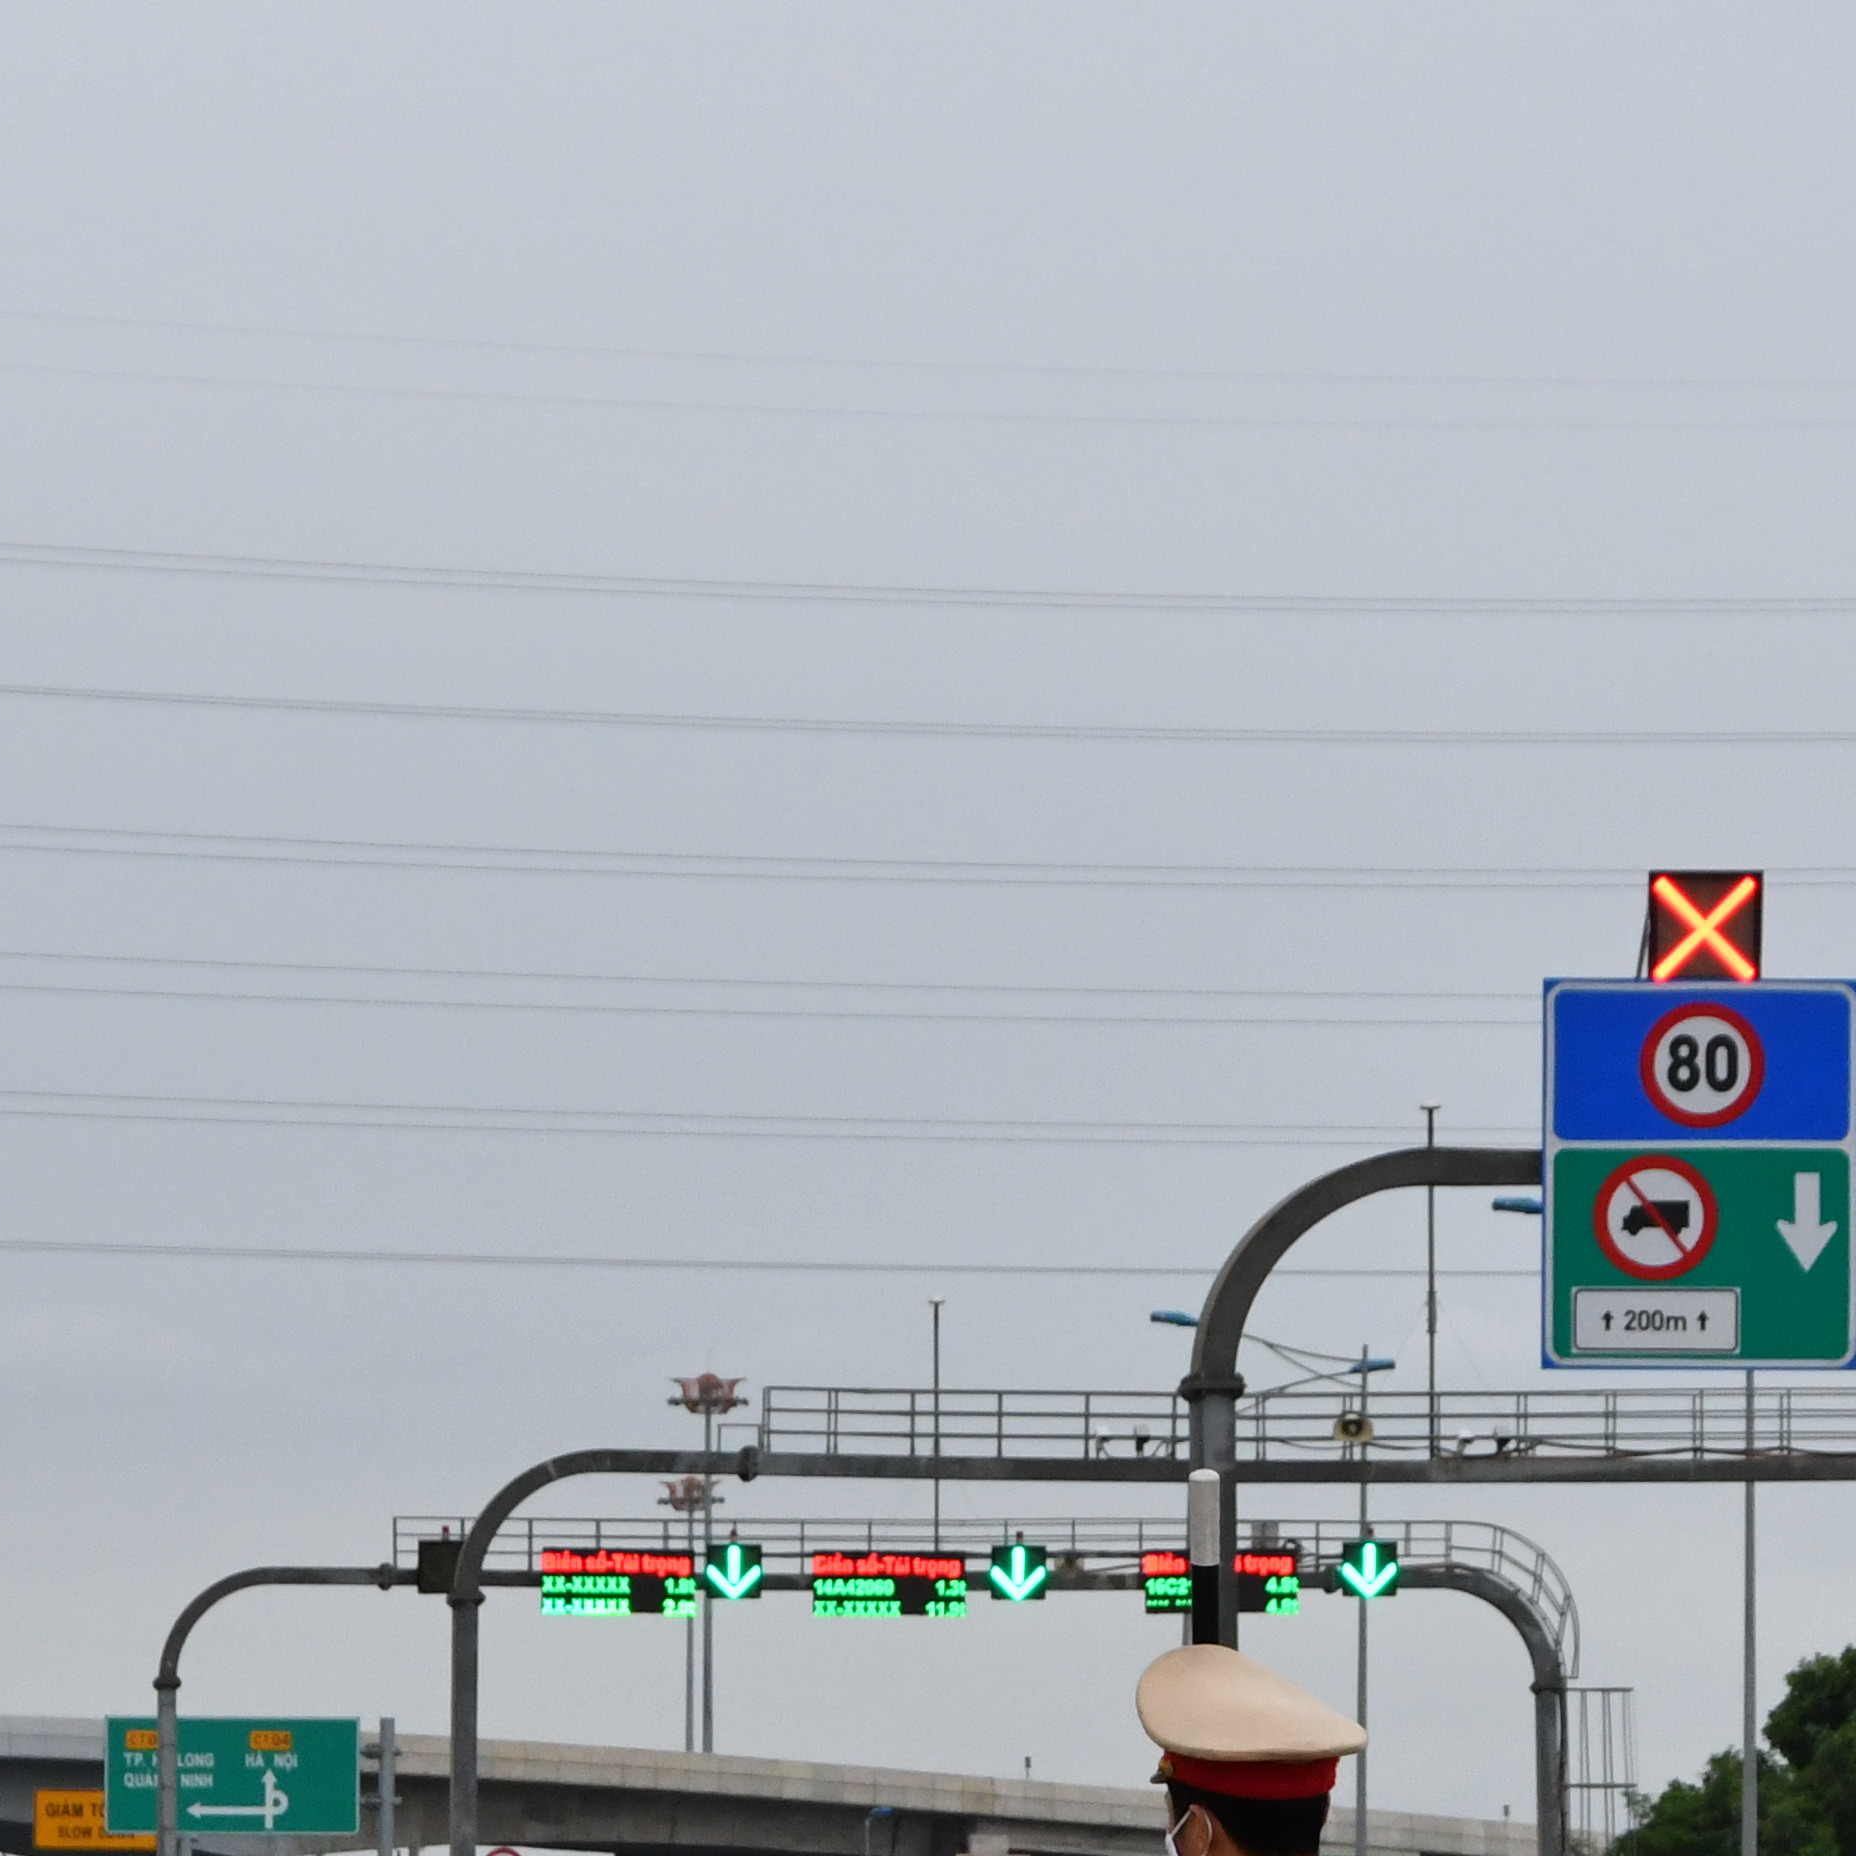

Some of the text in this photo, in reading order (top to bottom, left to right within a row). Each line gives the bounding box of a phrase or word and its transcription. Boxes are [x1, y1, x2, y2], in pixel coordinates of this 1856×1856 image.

[1666, 1033, 1739, 1092] 80
[1624, 1309, 1688, 1331] 200m
[1145, 1577, 1192, 1596] 16C2
[177, 1752, 215, 1767] LONG
[180, 1773, 214, 1787] NINH
